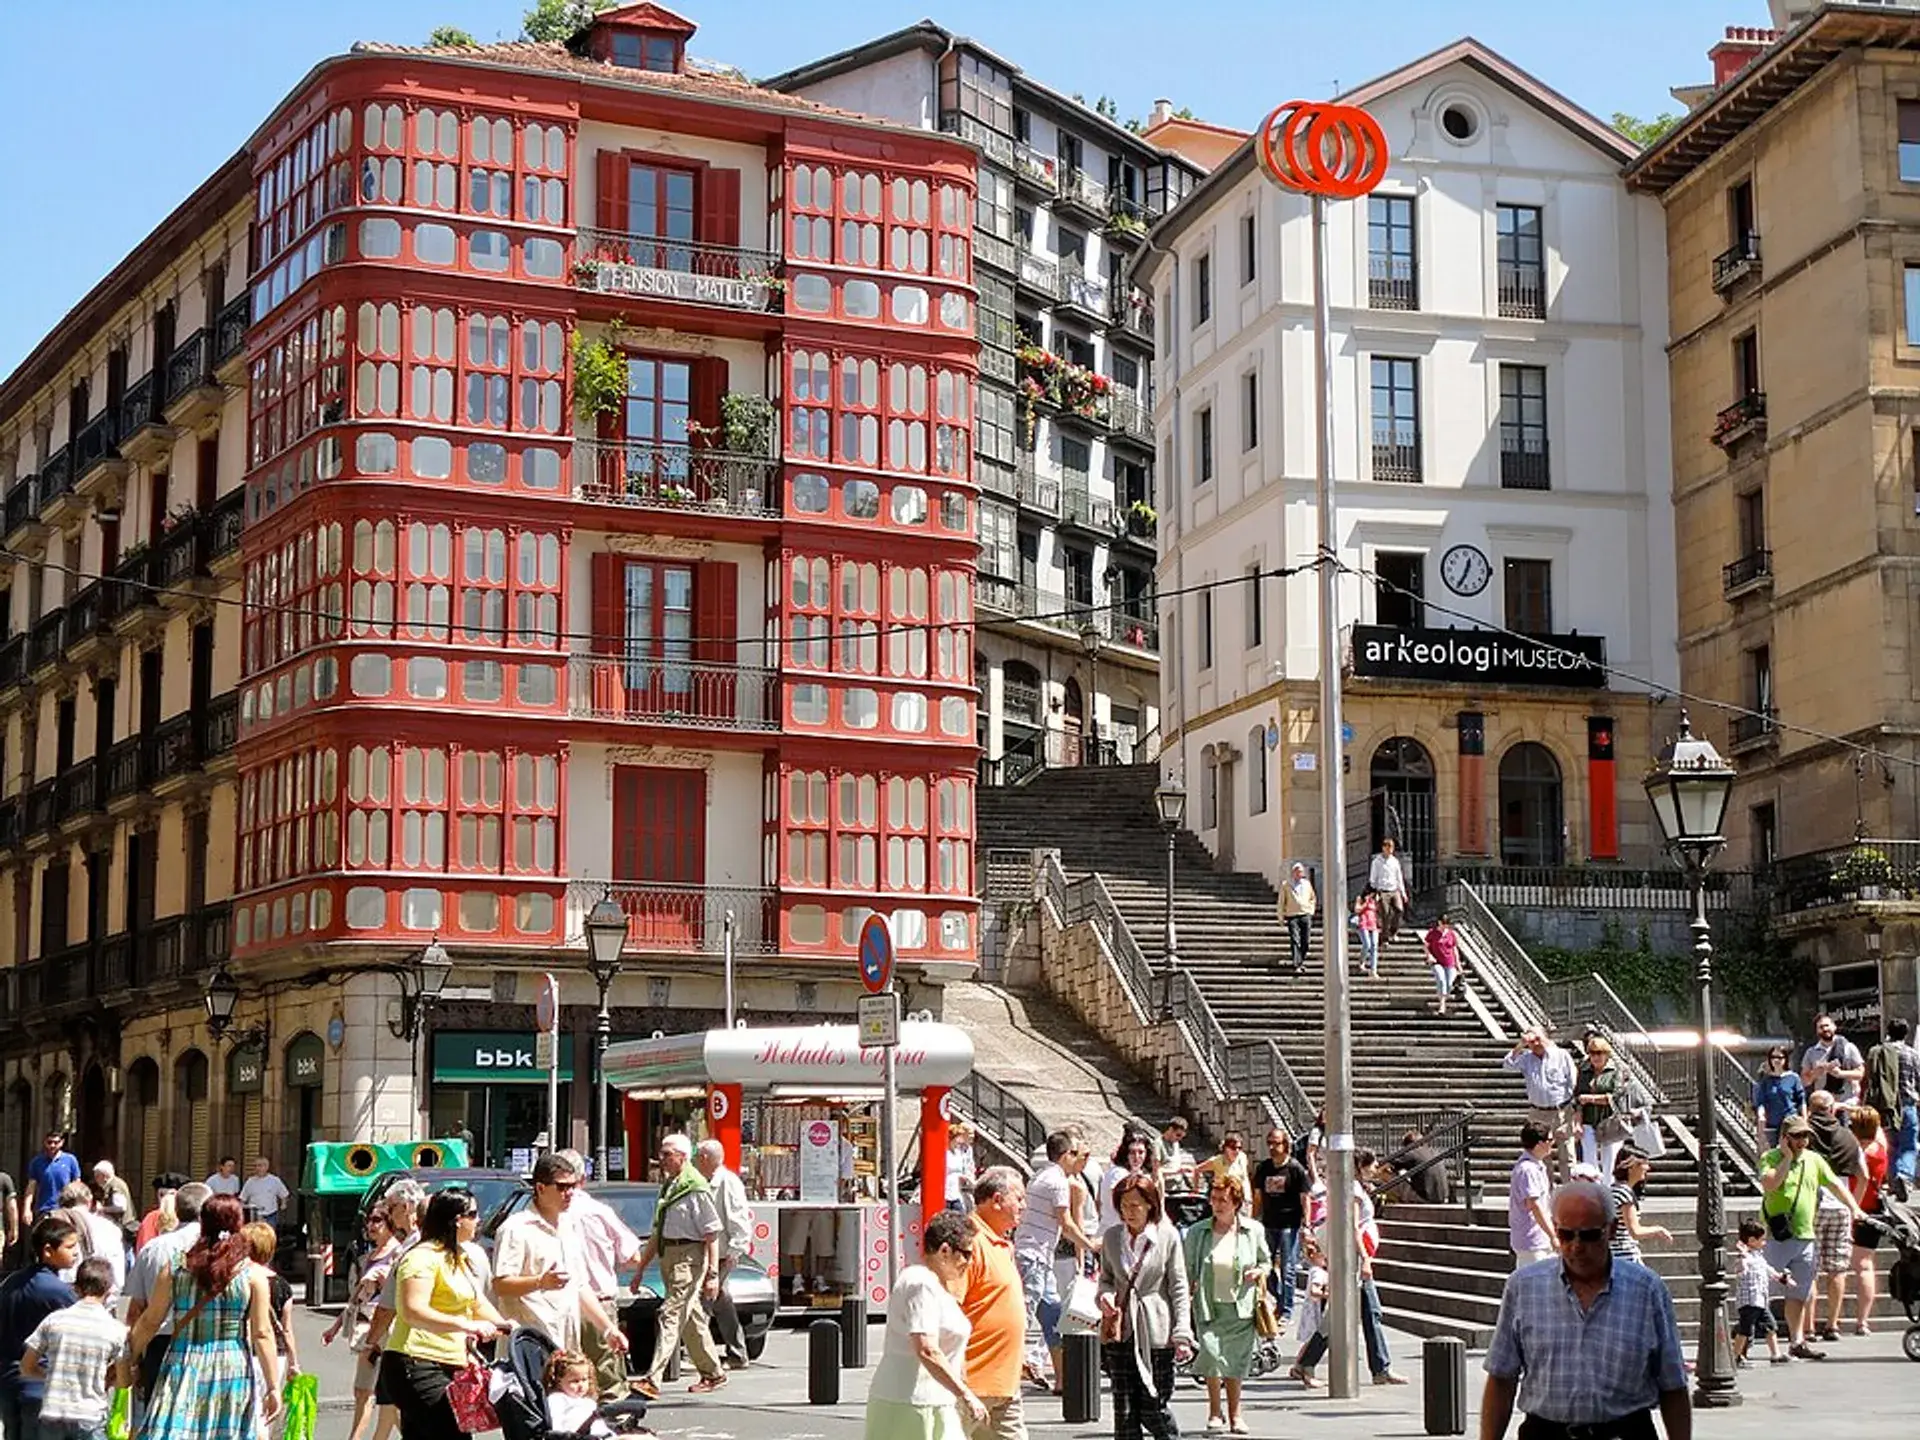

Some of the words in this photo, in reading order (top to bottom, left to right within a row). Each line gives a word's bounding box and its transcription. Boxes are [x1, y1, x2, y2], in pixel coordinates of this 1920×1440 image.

[296, 1057, 318, 1076] bbk
[475, 1048, 534, 1068] bbk
[239, 1065, 258, 1082] bbk
